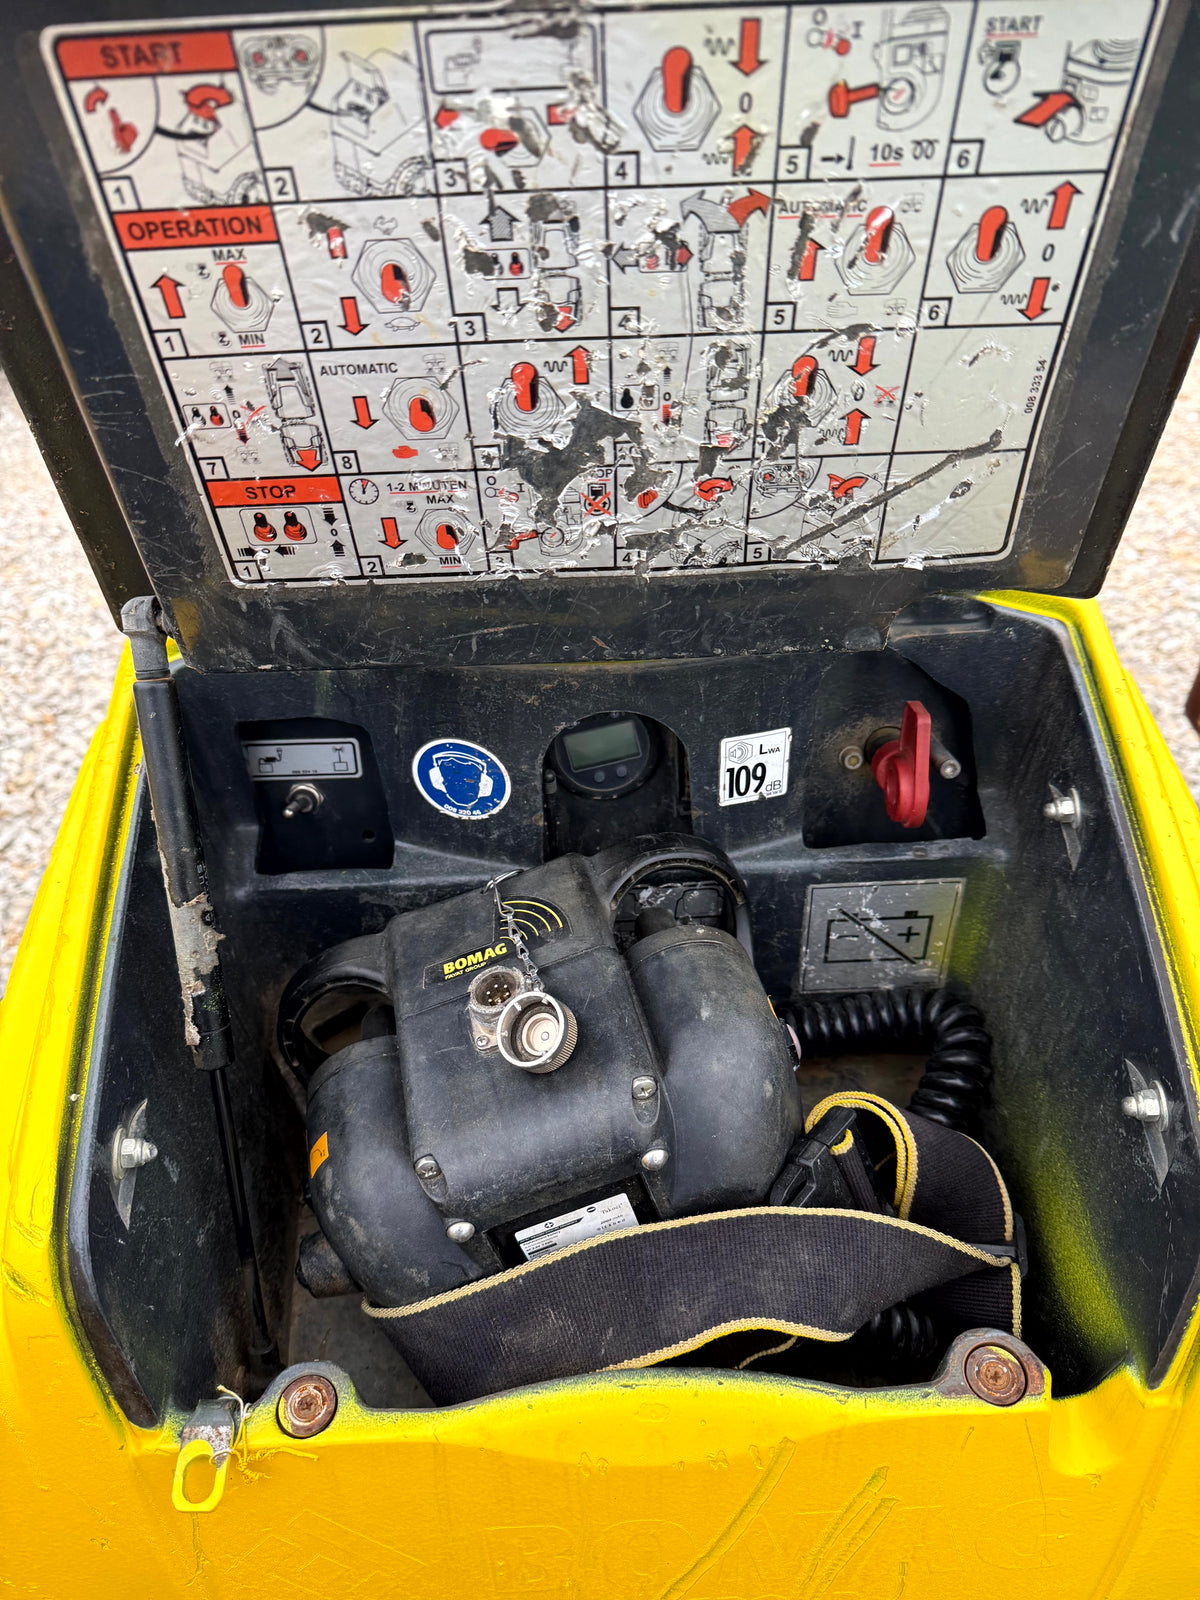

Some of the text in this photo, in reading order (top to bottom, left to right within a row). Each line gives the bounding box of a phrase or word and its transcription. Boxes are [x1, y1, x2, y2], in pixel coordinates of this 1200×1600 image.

[986, 15, 1043, 32] START
[100, 41, 183, 70] START
[870, 145, 904, 161] 10s
[957, 149, 970, 168] 6
[614, 161, 628, 178] 4
[785, 155, 799, 174] 5
[443, 168, 458, 187] 3
[273, 177, 289, 196] 2
[113, 188, 125, 204] 1
[127, 216, 263, 241] OPERATION
[212, 248, 247, 261] MAX
[773, 309, 786, 325] 5
[928, 304, 940, 321] 6
[310, 328, 323, 344] 2
[464, 320, 476, 336] 3
[165, 336, 175, 352] 1
[238, 333, 265, 345] MIN
[320, 362, 398, 376] AUTOMATIC
[206, 462, 217, 475] 7
[342, 456, 352, 469] 8
[244, 485, 296, 500] STOP
[386, 482, 405, 492] 1-2
[426, 494, 455, 505] MAX
[440, 556, 461, 565] MIN
[753, 547, 762, 559] 5
[243, 566, 252, 577] 1
[367, 561, 378, 573] 2
[726, 762, 781, 798] 109 dB
[443, 943, 508, 975] BOMAG
[444, 961, 487, 980] FAYAT GROUP
